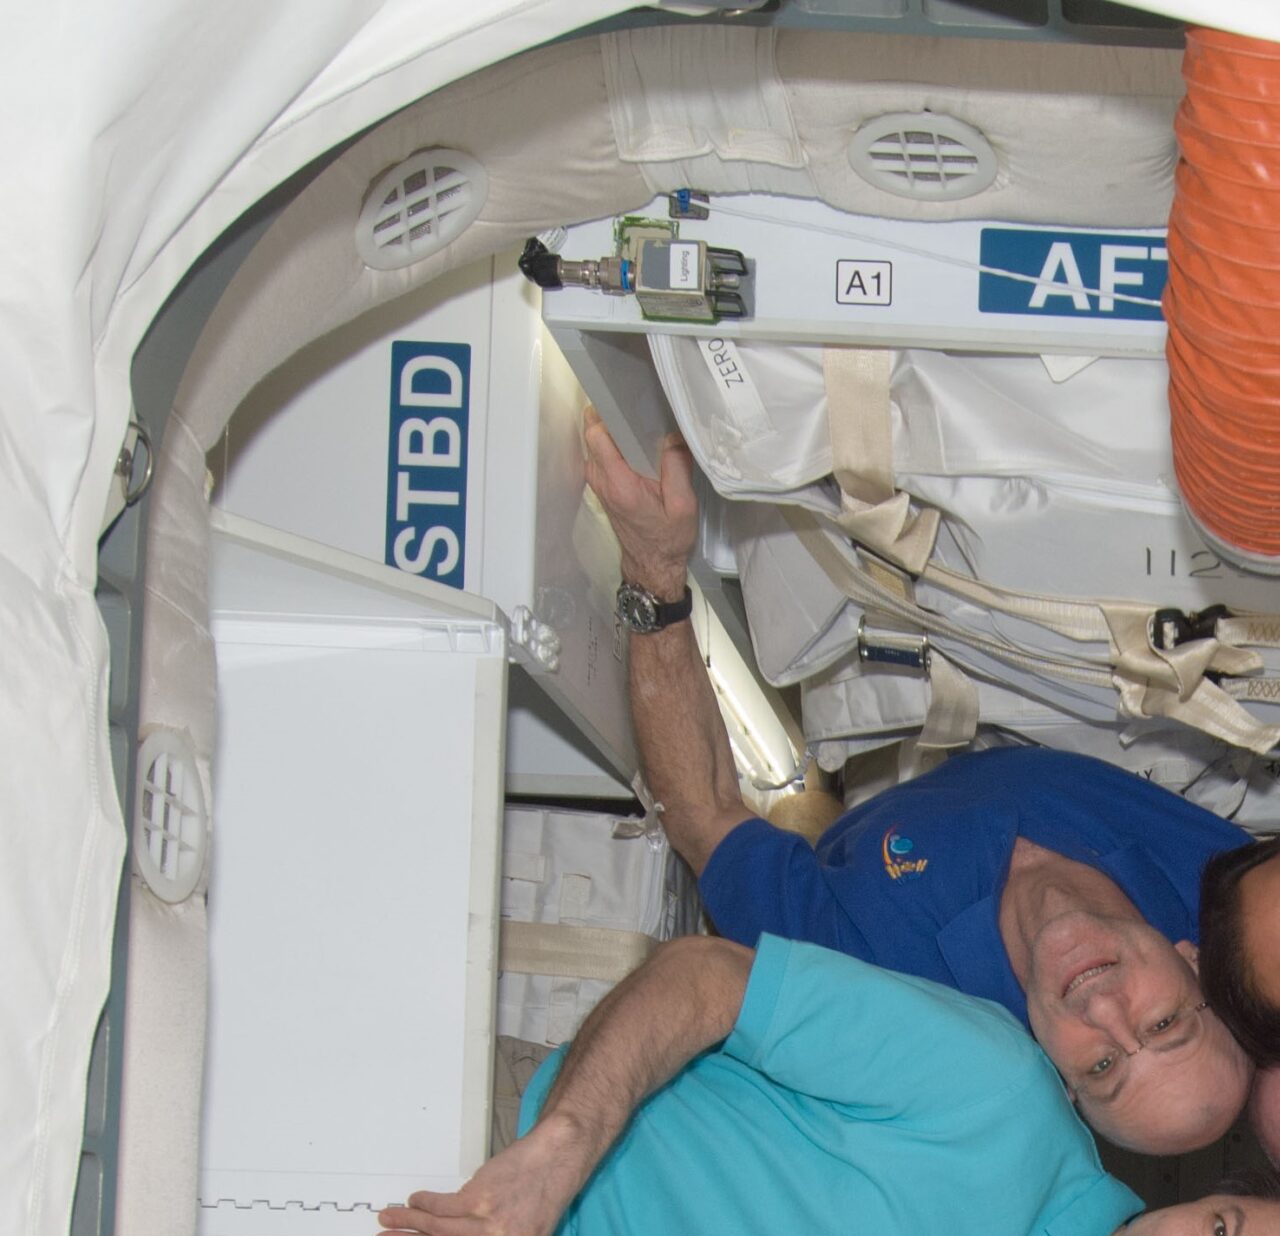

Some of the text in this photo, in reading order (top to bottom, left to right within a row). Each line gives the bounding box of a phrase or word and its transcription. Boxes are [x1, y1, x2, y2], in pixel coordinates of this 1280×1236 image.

[845, 270, 882, 297] A1
[1028, 241, 1168, 311] AF
[708, 337, 744, 389] ZERO
[393, 355, 463, 576] STBD
